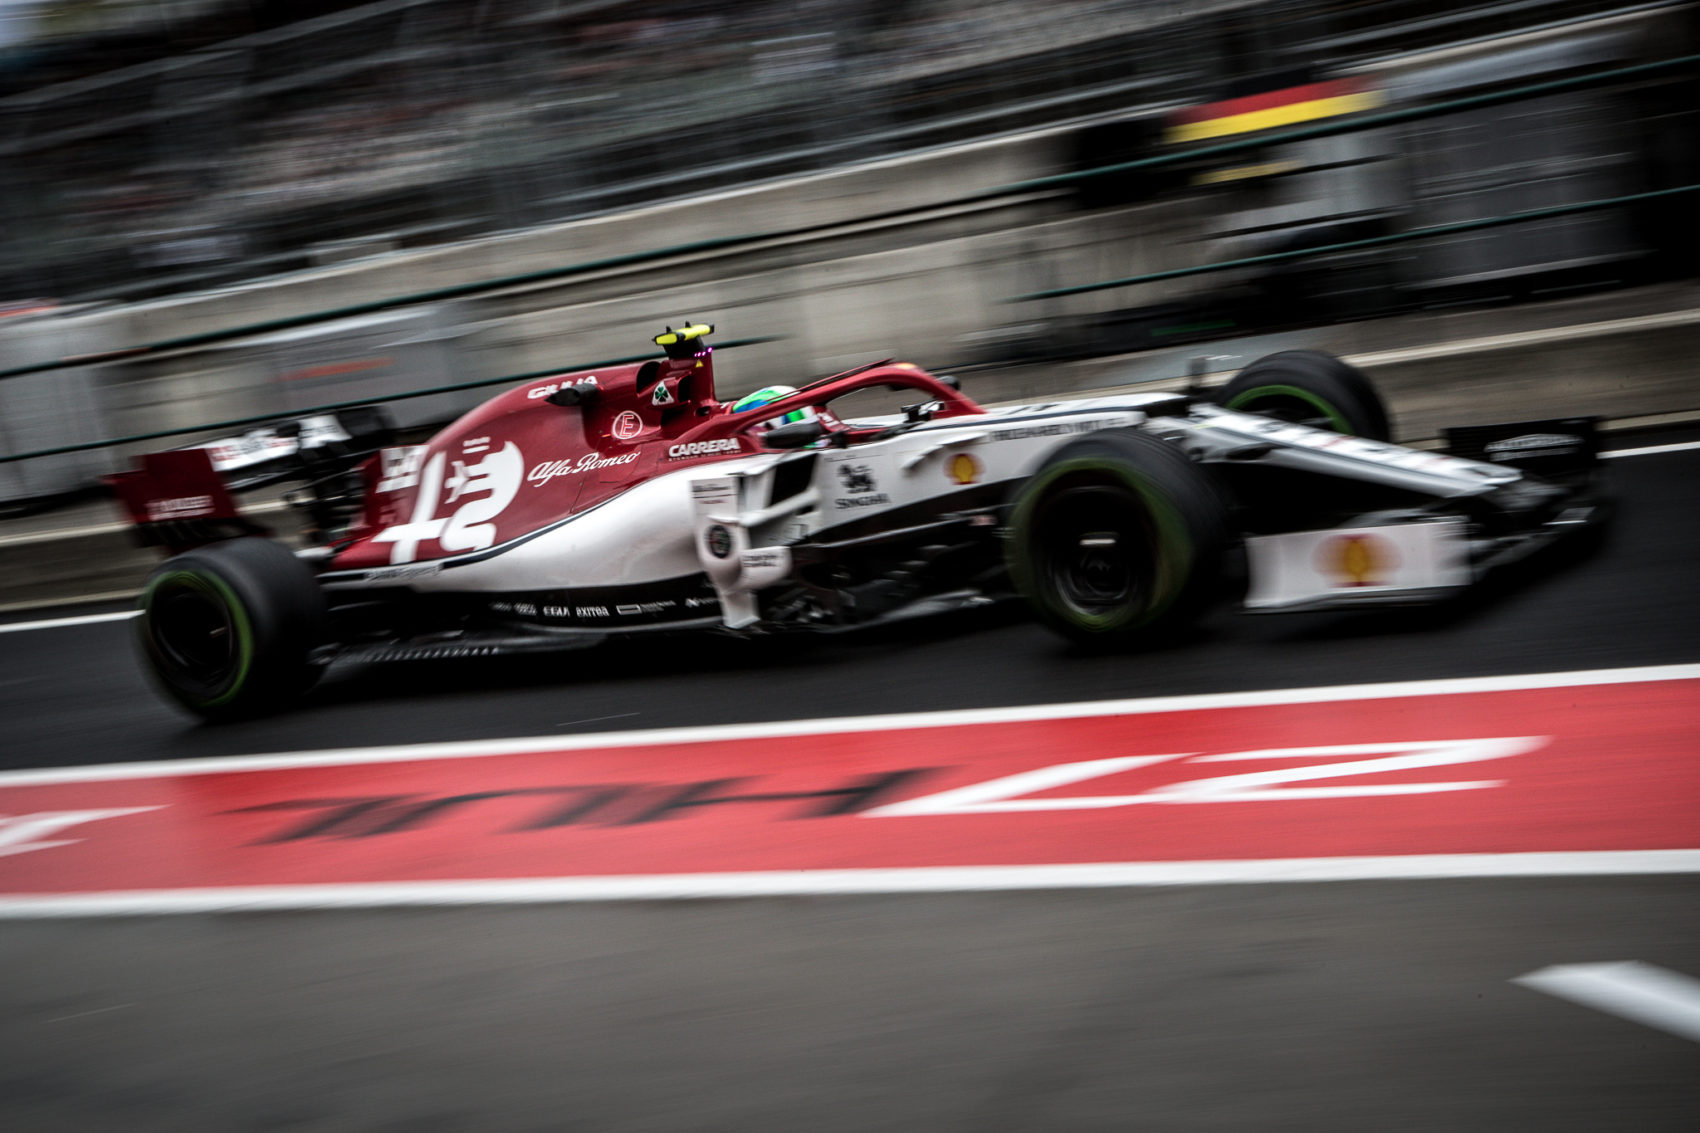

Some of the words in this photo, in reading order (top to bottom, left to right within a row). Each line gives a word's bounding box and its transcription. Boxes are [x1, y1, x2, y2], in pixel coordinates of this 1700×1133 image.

[668, 438, 741, 457] CARRERA
[527, 459, 573, 487] Alfa
[571, 452, 641, 473] Romeo
